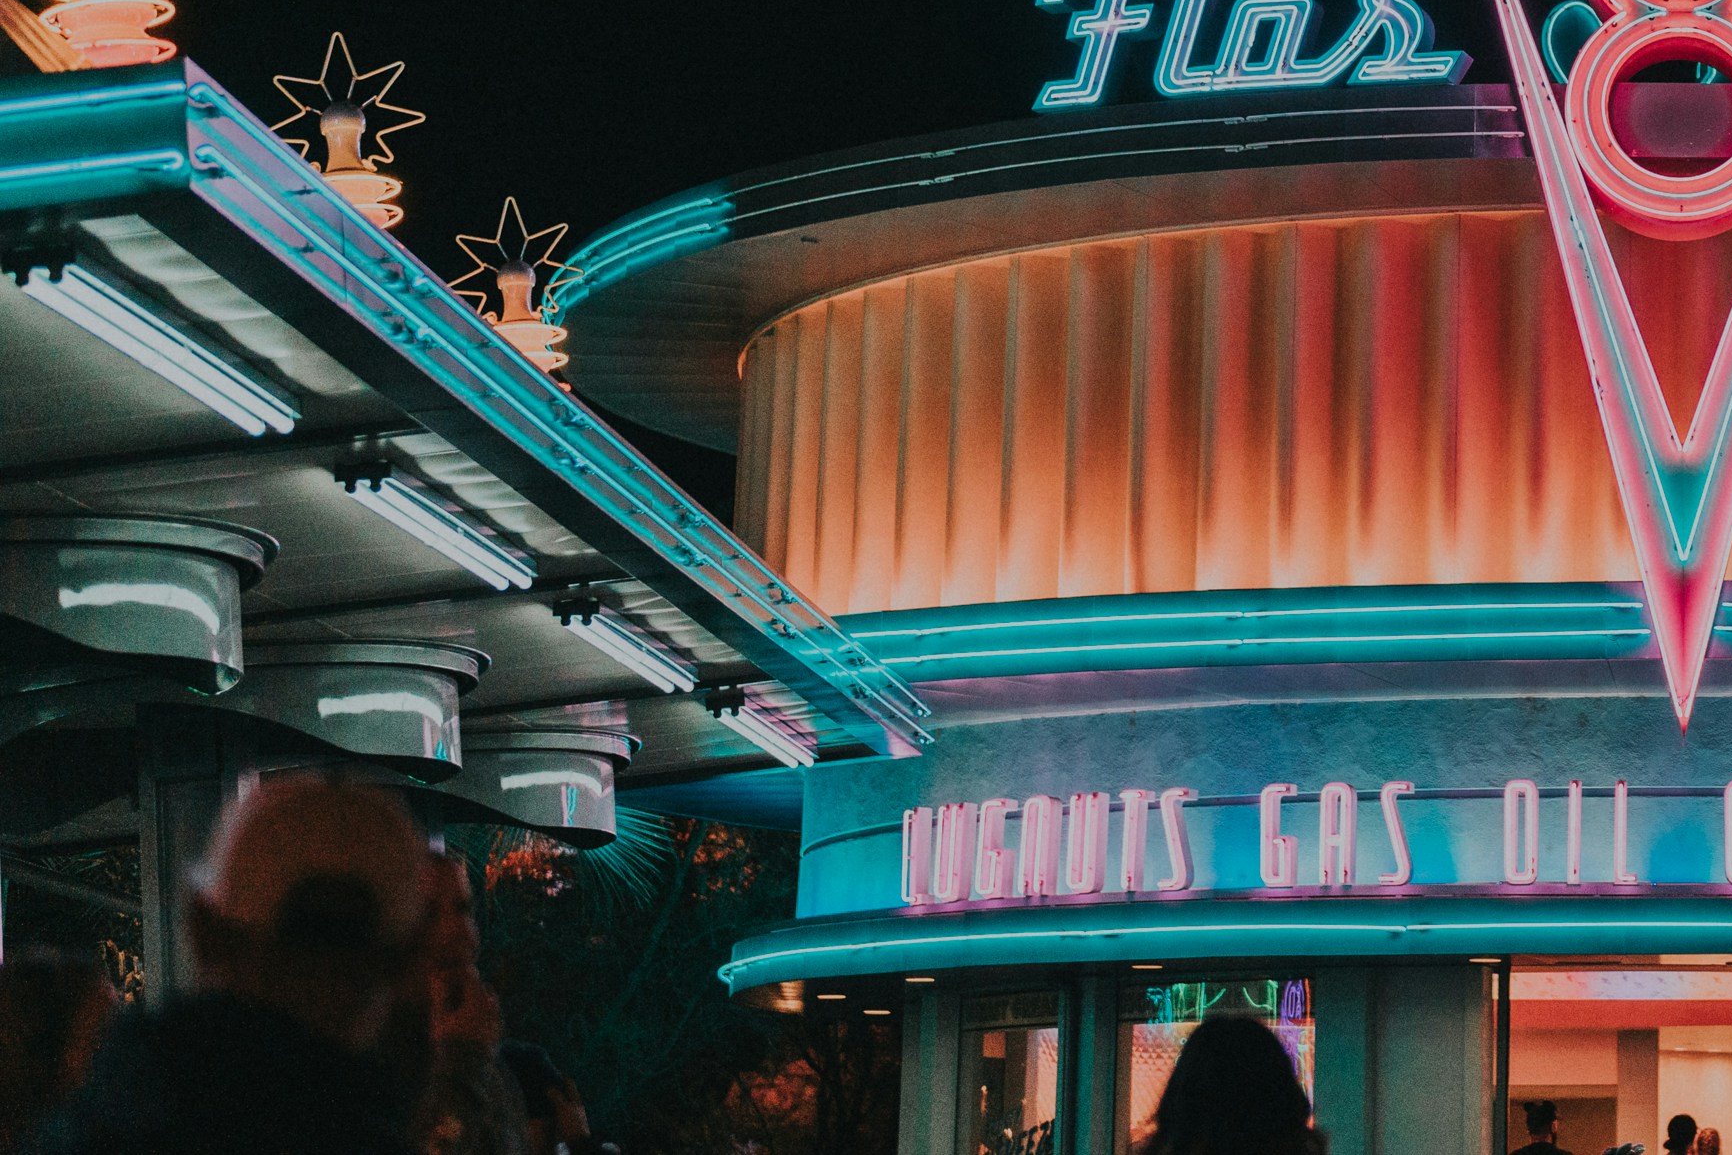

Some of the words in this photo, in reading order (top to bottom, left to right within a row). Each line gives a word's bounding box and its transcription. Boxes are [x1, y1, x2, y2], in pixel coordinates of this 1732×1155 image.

[901, 787, 1199, 906] LUGNUTS
[1260, 781, 1415, 888] GAS
[1503, 779, 1638, 886] OIL
